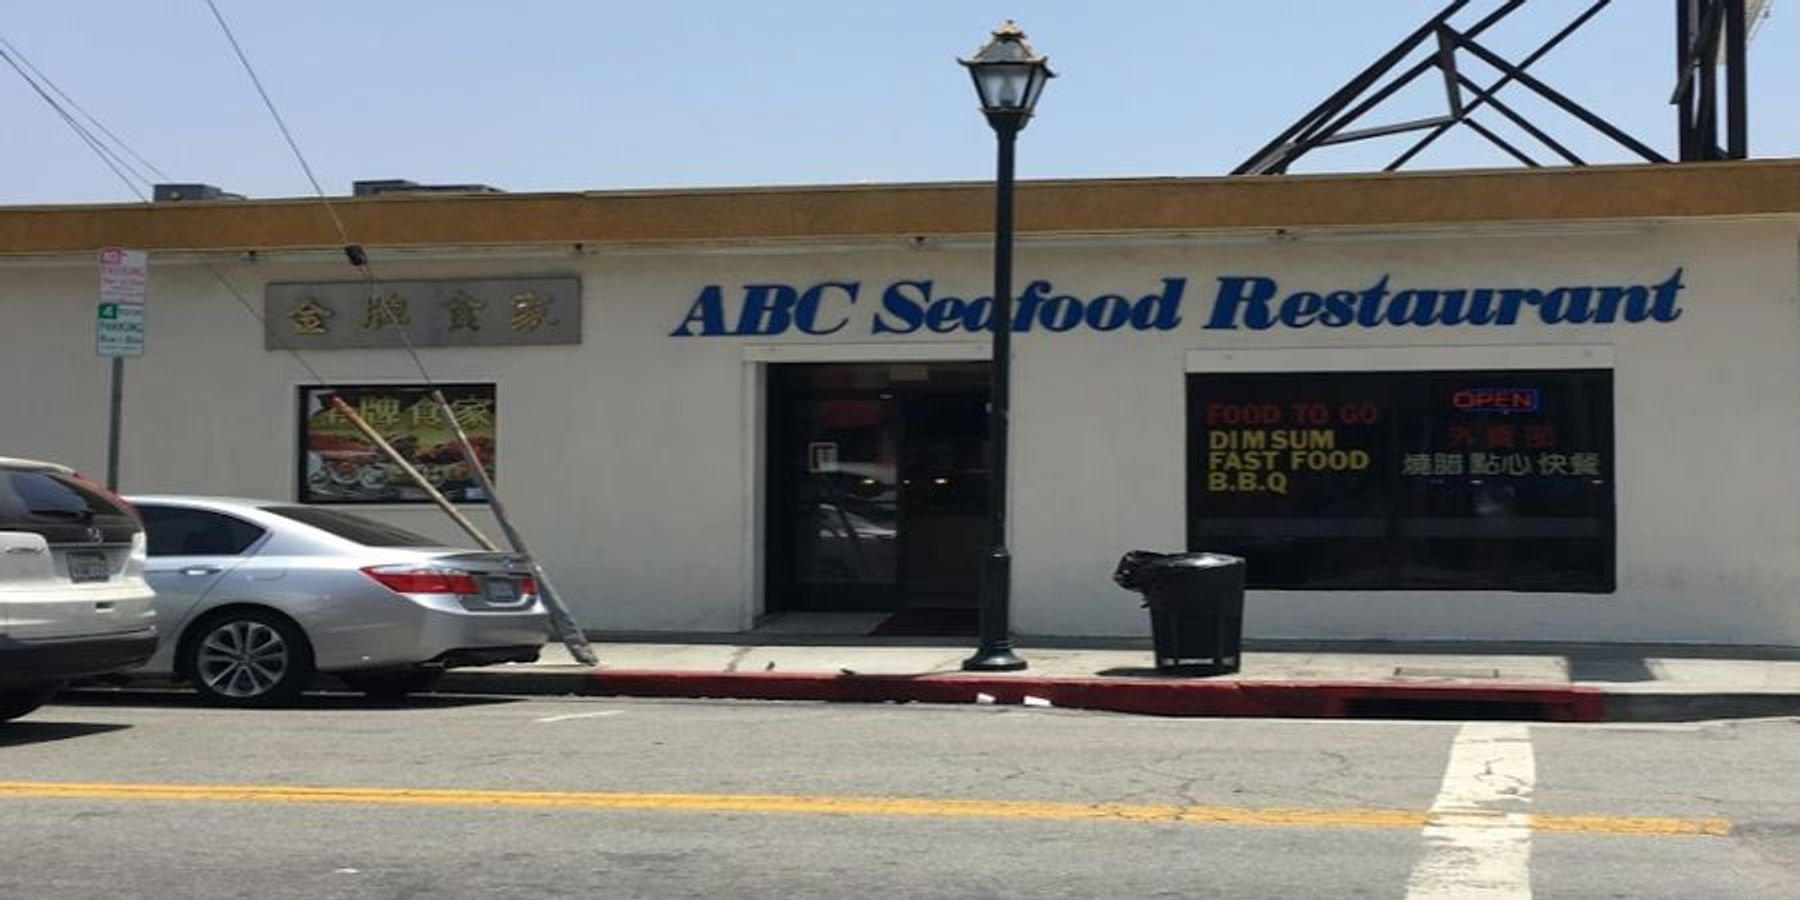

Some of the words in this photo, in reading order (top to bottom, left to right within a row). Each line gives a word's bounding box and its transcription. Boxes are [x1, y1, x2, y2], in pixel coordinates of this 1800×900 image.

[669, 281, 860, 337] ABC
[872, 278, 1187, 335] Seafood
[1202, 267, 1685, 331] Restaurant
[1453, 391, 1533, 409] OPEN
[1207, 404, 1281, 424] FOOD
[1293, 404, 1328, 424] TO
[1340, 404, 1377, 424] GO
[1209, 430, 1265, 450] DIM
[1271, 430, 1336, 450] SUM
[1208, 451, 1279, 471] FAST
[1290, 451, 1371, 471] FOOD
[1208, 472, 1288, 495] B.B.Q
